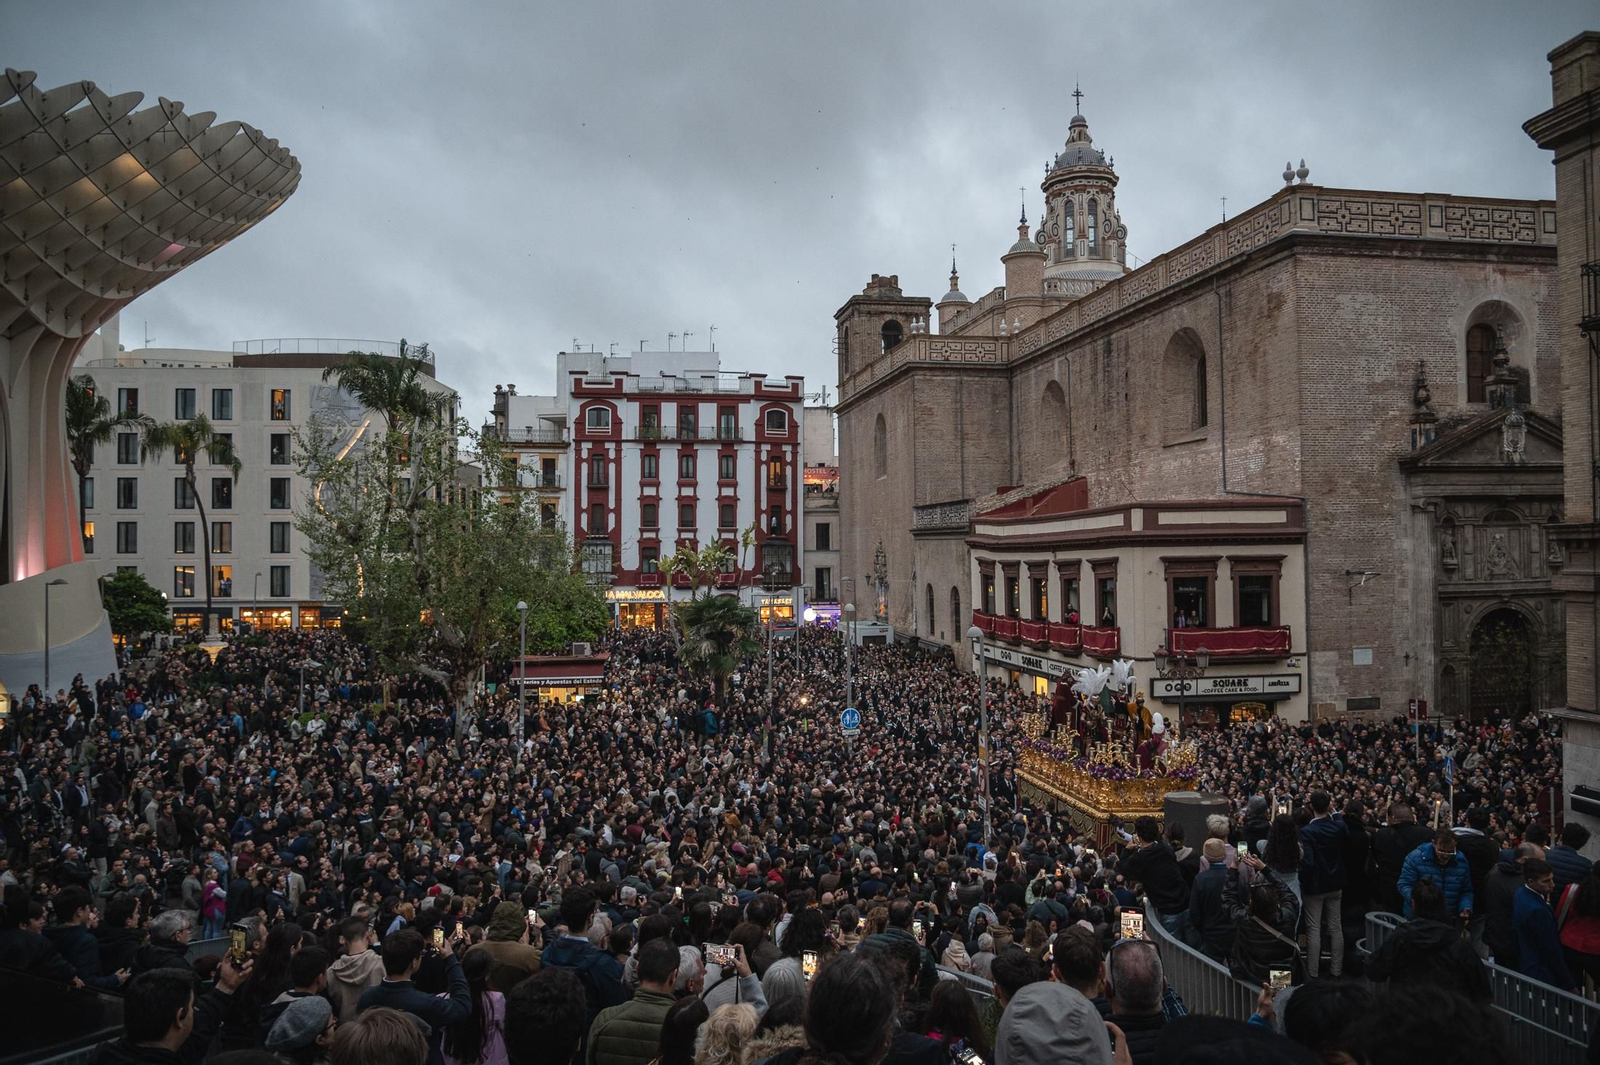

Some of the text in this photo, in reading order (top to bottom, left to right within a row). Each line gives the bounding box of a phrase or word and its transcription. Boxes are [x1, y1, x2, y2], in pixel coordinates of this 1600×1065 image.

[616, 590, 665, 599] MALVALOCA
[1021, 656, 1043, 669] SQUARE
[1213, 679, 1248, 687] SQUARE
